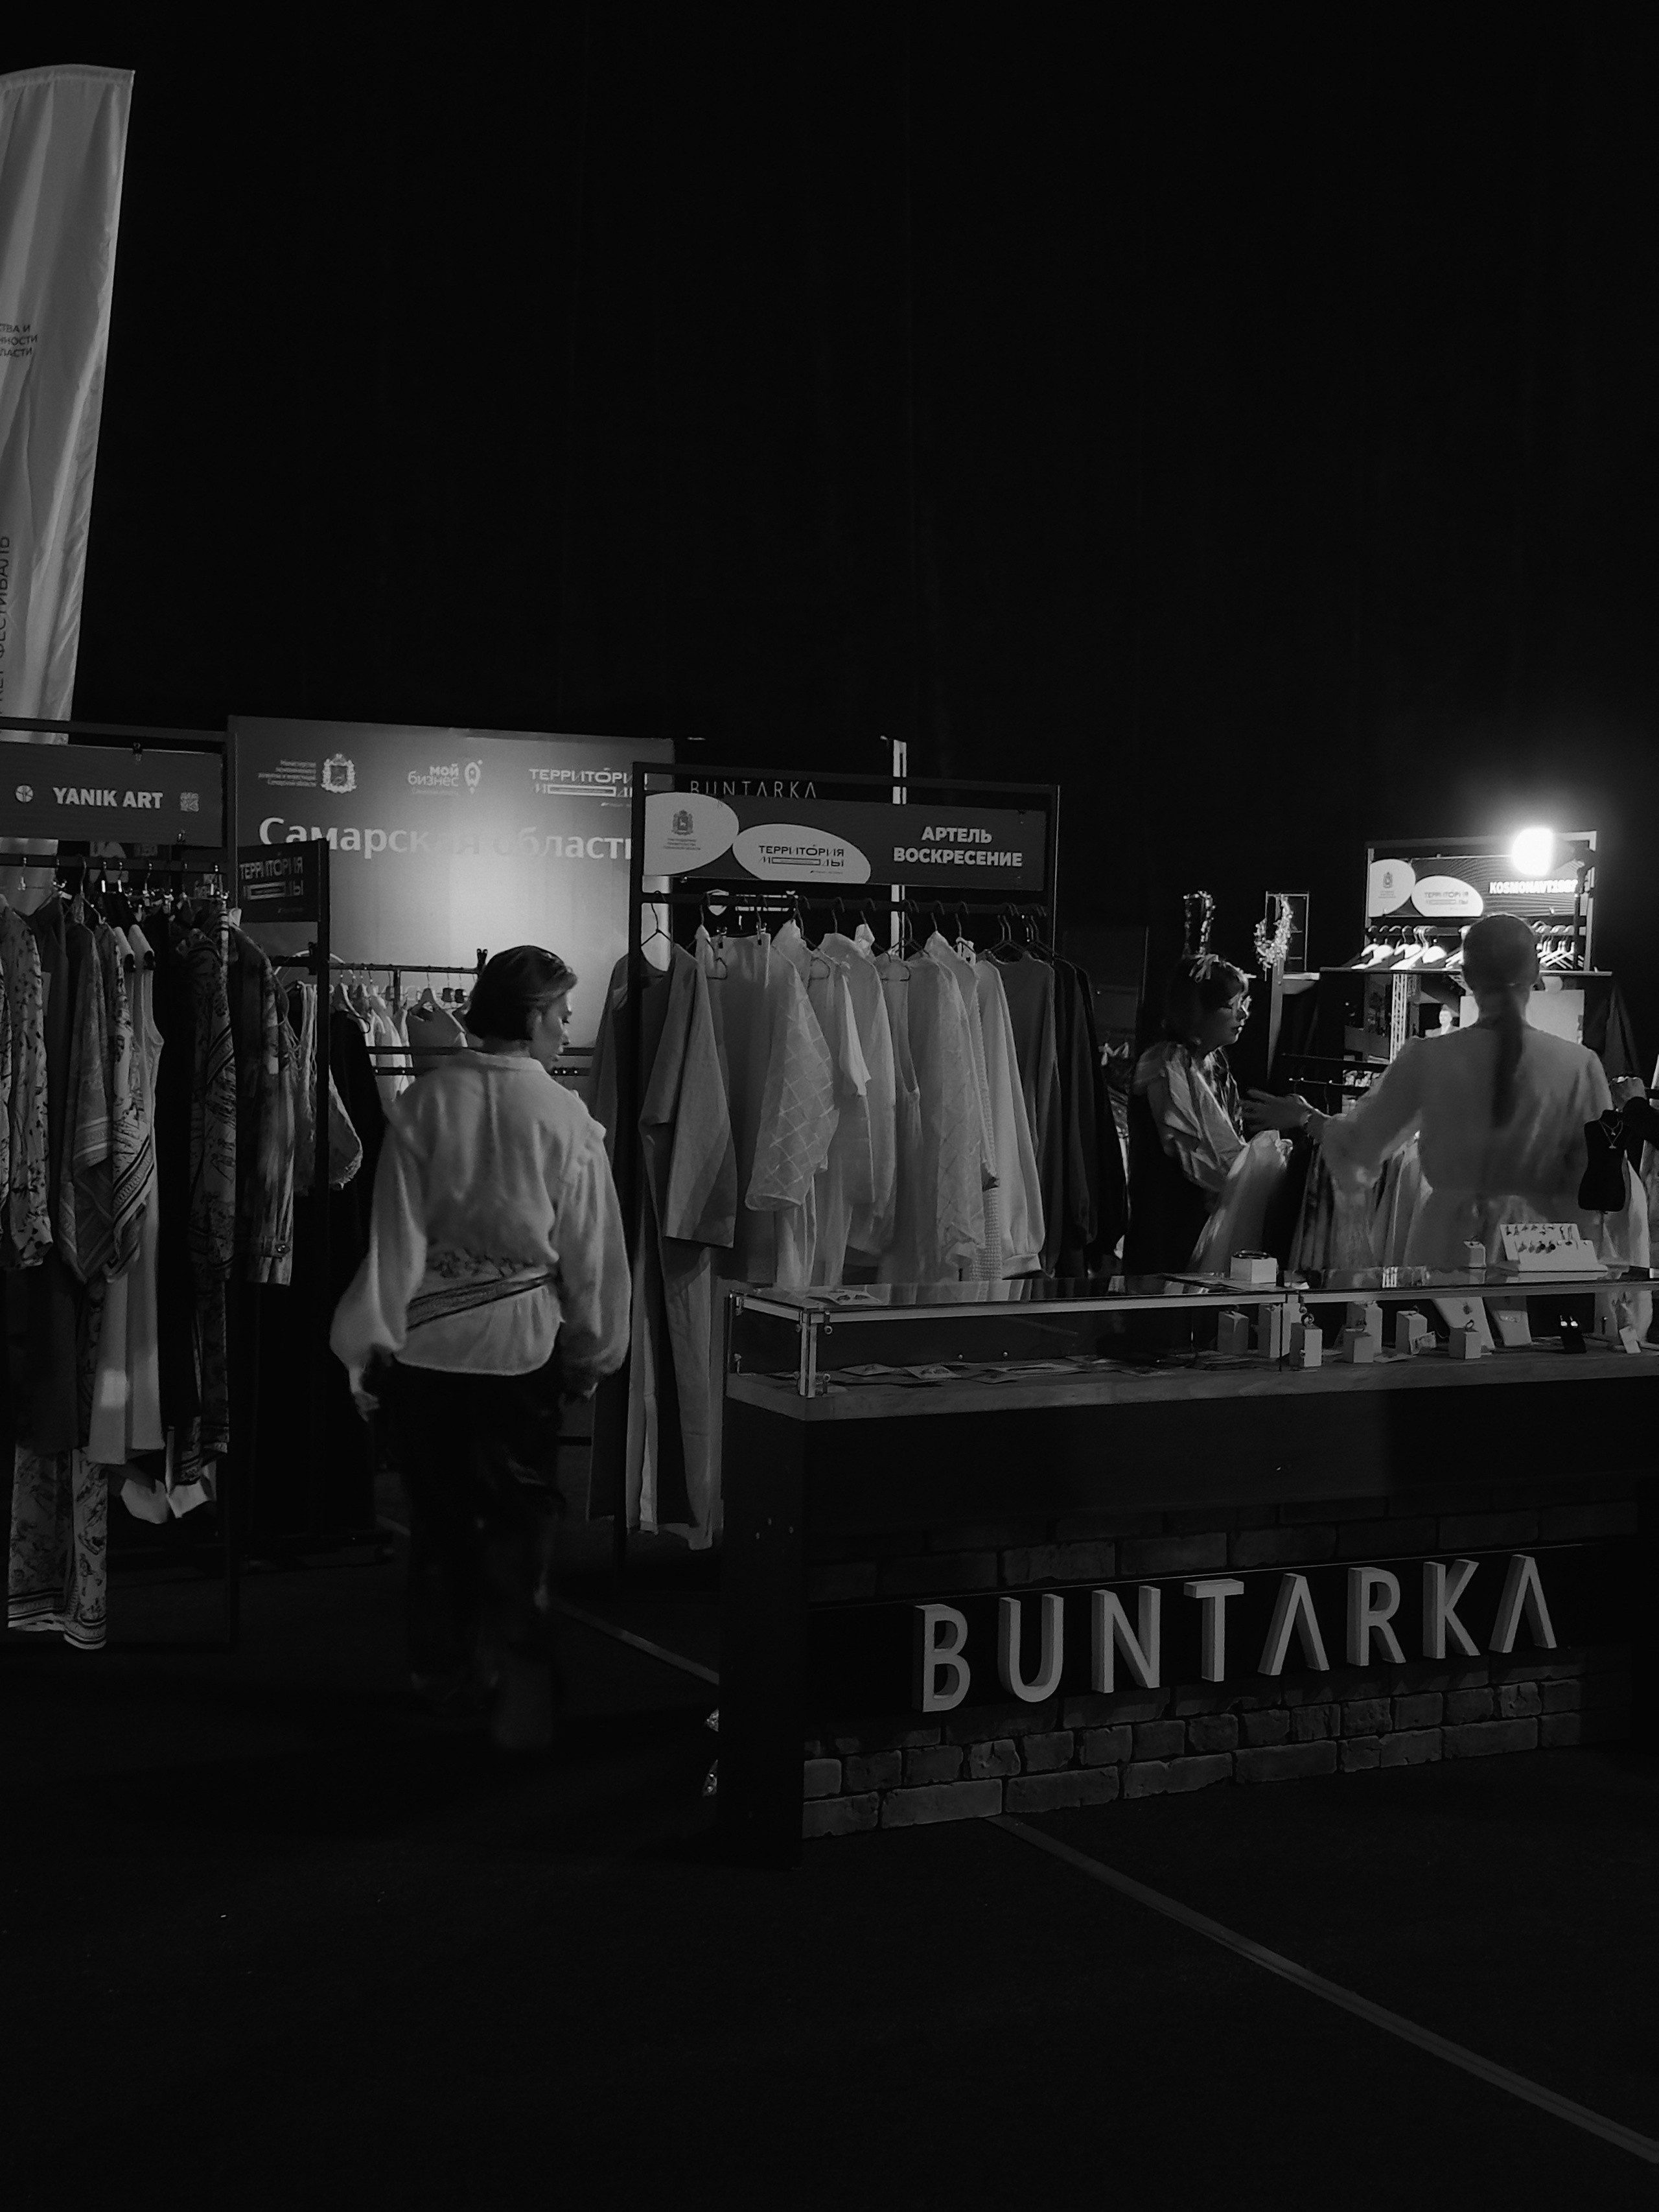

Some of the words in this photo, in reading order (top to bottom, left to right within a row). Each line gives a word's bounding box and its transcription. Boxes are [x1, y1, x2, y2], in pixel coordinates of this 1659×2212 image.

[408, 770, 459, 787] бизнес
[53, 786, 118, 807] YANIK
[122, 791, 163, 809] ART
[921, 826, 993, 844] АРТЕЛЬ
[893, 846, 1023, 867] ВОСКРЕСЕНИЕ
[914, 1554, 1557, 1712] BUNTARKA
